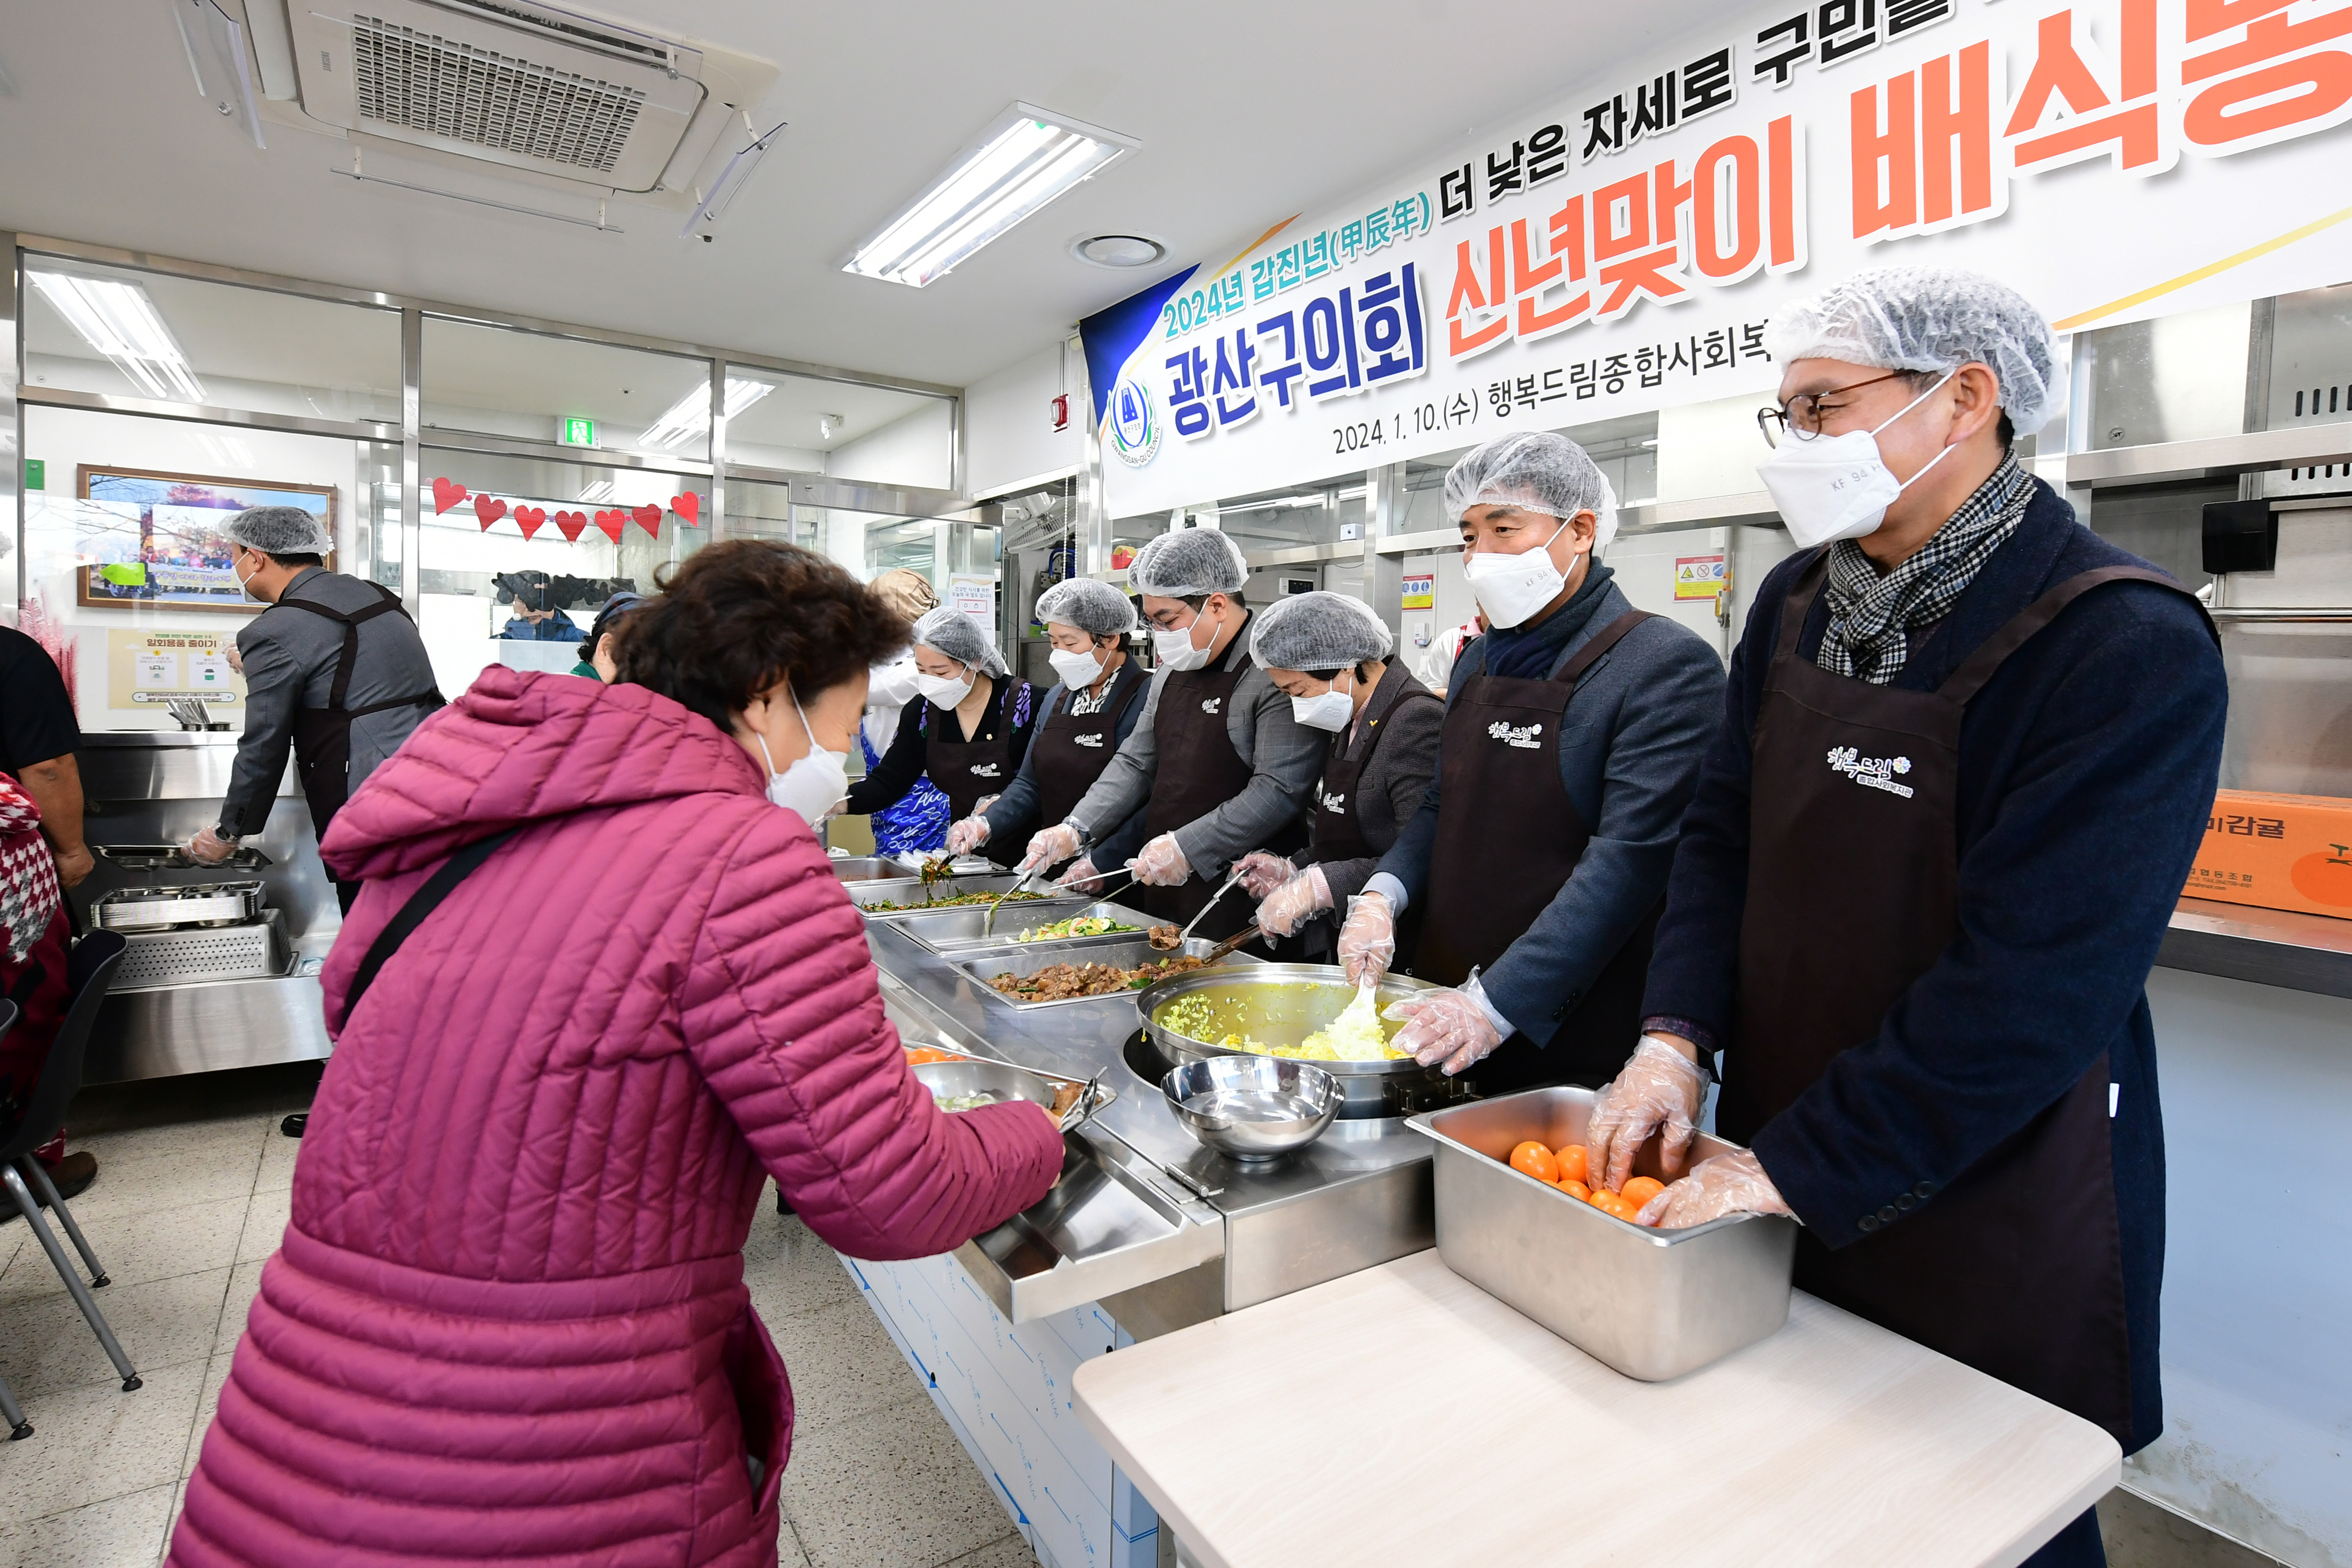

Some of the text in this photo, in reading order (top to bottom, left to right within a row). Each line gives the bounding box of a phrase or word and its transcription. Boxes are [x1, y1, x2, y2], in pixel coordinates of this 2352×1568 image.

[321, 51, 332, 72] SAMSUNG
[1164, 270, 1244, 338] 2024년
[1252, 191, 1430, 300] 갑진년(甲辰年)
[1440, 163, 1473, 219] 더
[1488, 124, 1567, 199] 낮은
[1583, 47, 1733, 158] 자세로
[1165, 262, 1424, 436] 광산구의회
[1445, 114, 1795, 357] 신년맞이
[1110, 425, 1160, 465] GWANGSAN-GU COUNCIL
[1333, 418, 1386, 454] 2024.
[1831, 469, 1868, 492] KF 94
[1525, 570, 1547, 588] KF 94
[147, 638, 217, 648] 일회용품 줄이기
[1488, 721, 1532, 742] 행복드림
[1828, 746, 1891, 779] 행복드림
[1858, 775, 1913, 798] 종합사회복지관
